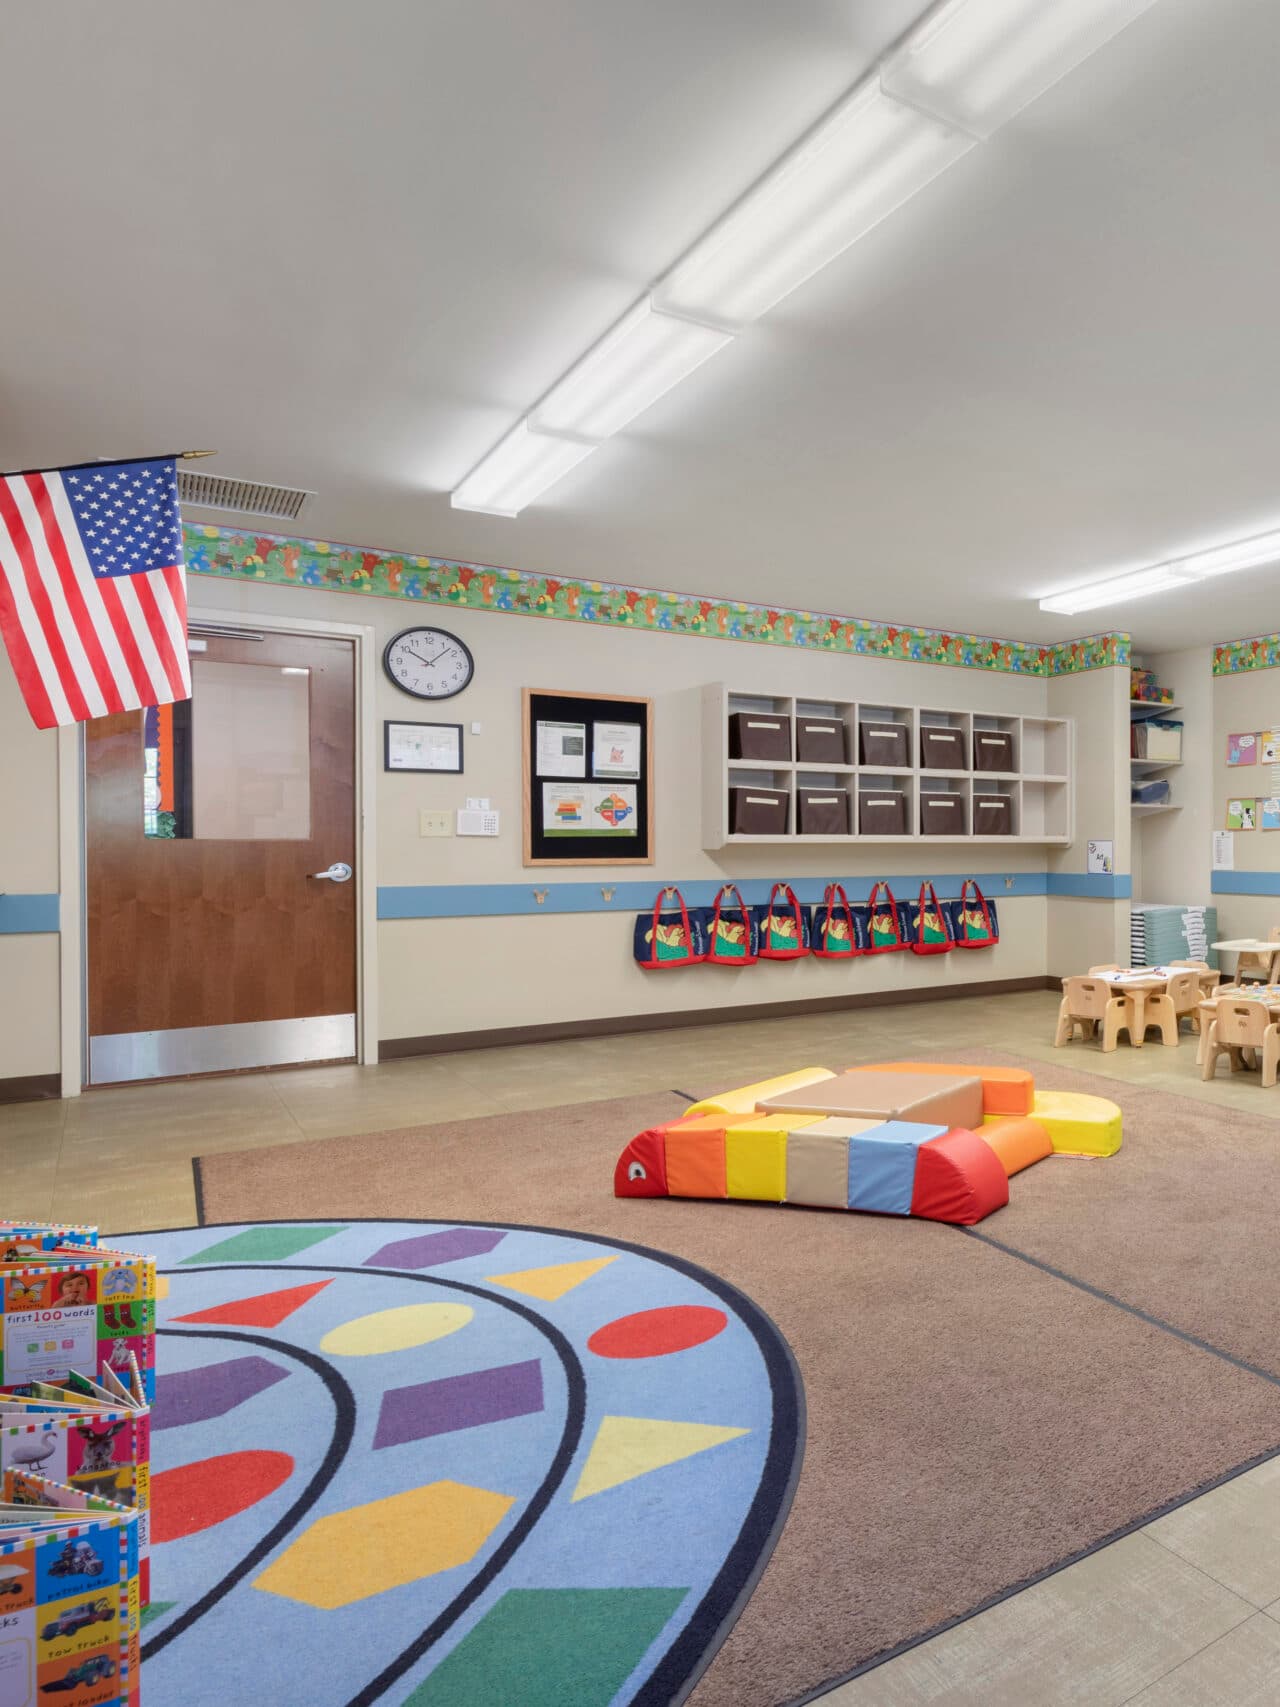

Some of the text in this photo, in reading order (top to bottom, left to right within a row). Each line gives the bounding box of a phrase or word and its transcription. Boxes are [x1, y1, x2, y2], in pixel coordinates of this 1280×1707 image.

[401, 669, 408, 677] 8
[456, 662, 462, 670] 3
[8, 1307, 95, 1324] first 100 words
[139, 1466, 148, 1488] first
[138, 1513, 148, 1548] animals
[129, 1581, 137, 1607] first
[48, 1635, 109, 1659] tow truck
